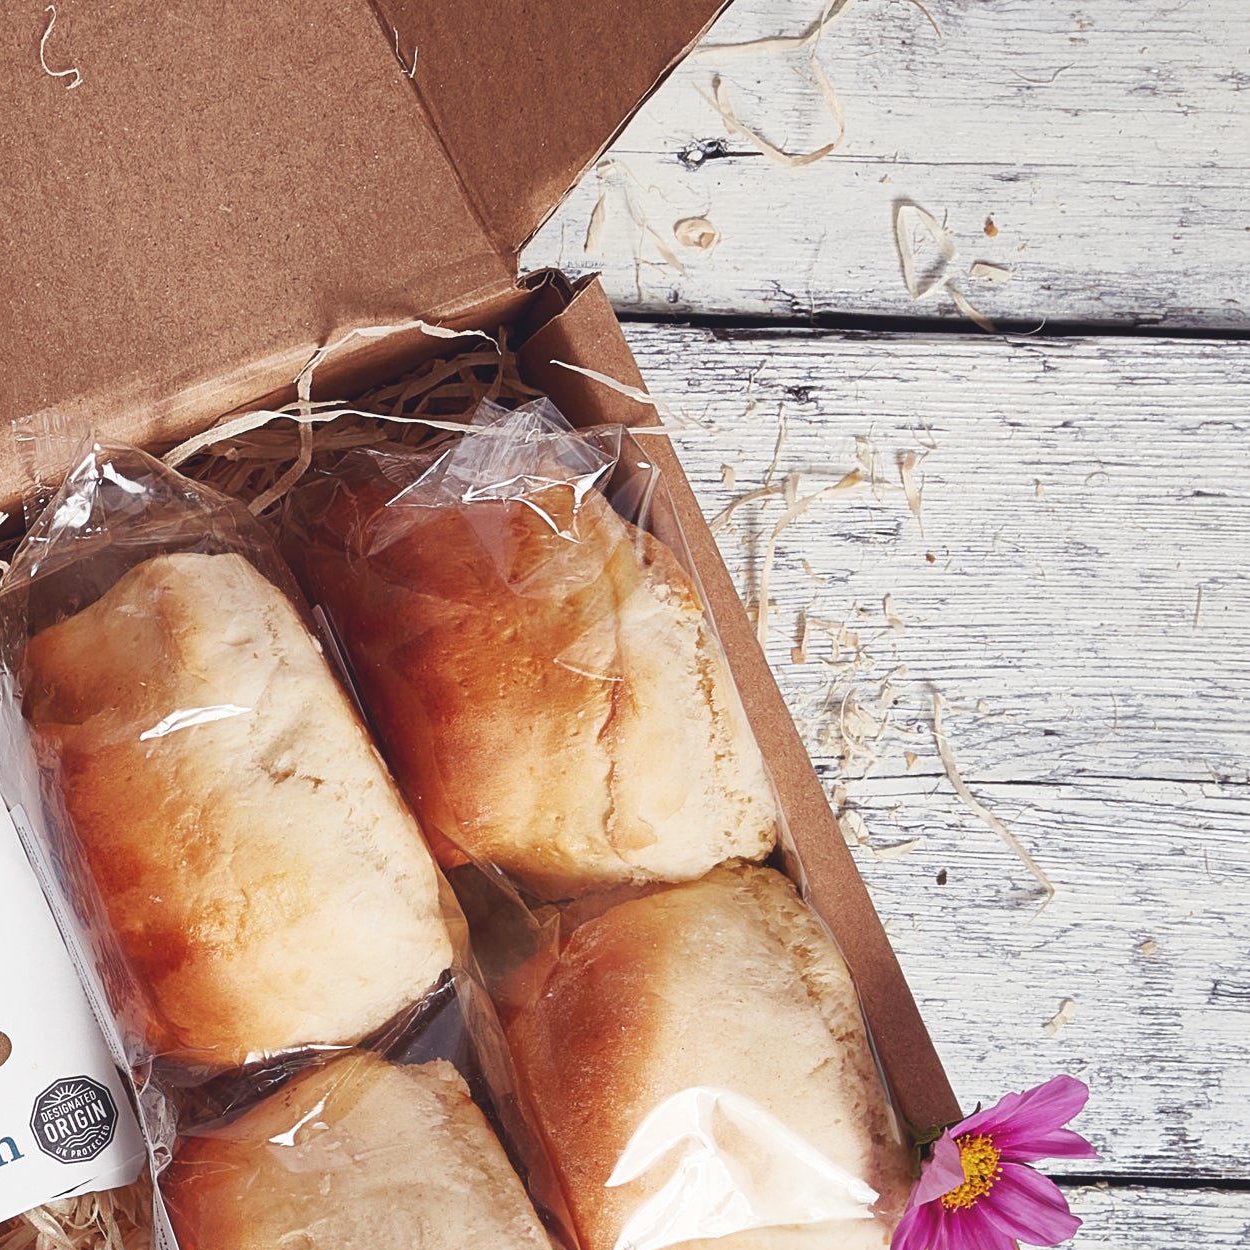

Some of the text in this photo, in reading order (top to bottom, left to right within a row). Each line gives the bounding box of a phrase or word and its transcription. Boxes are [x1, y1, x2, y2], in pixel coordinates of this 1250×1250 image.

[40, 1090, 97, 1123] DESIGNATED
[43, 1099, 108, 1143] ORIGIN
[55, 1125, 110, 1158] UK PROTECTED
